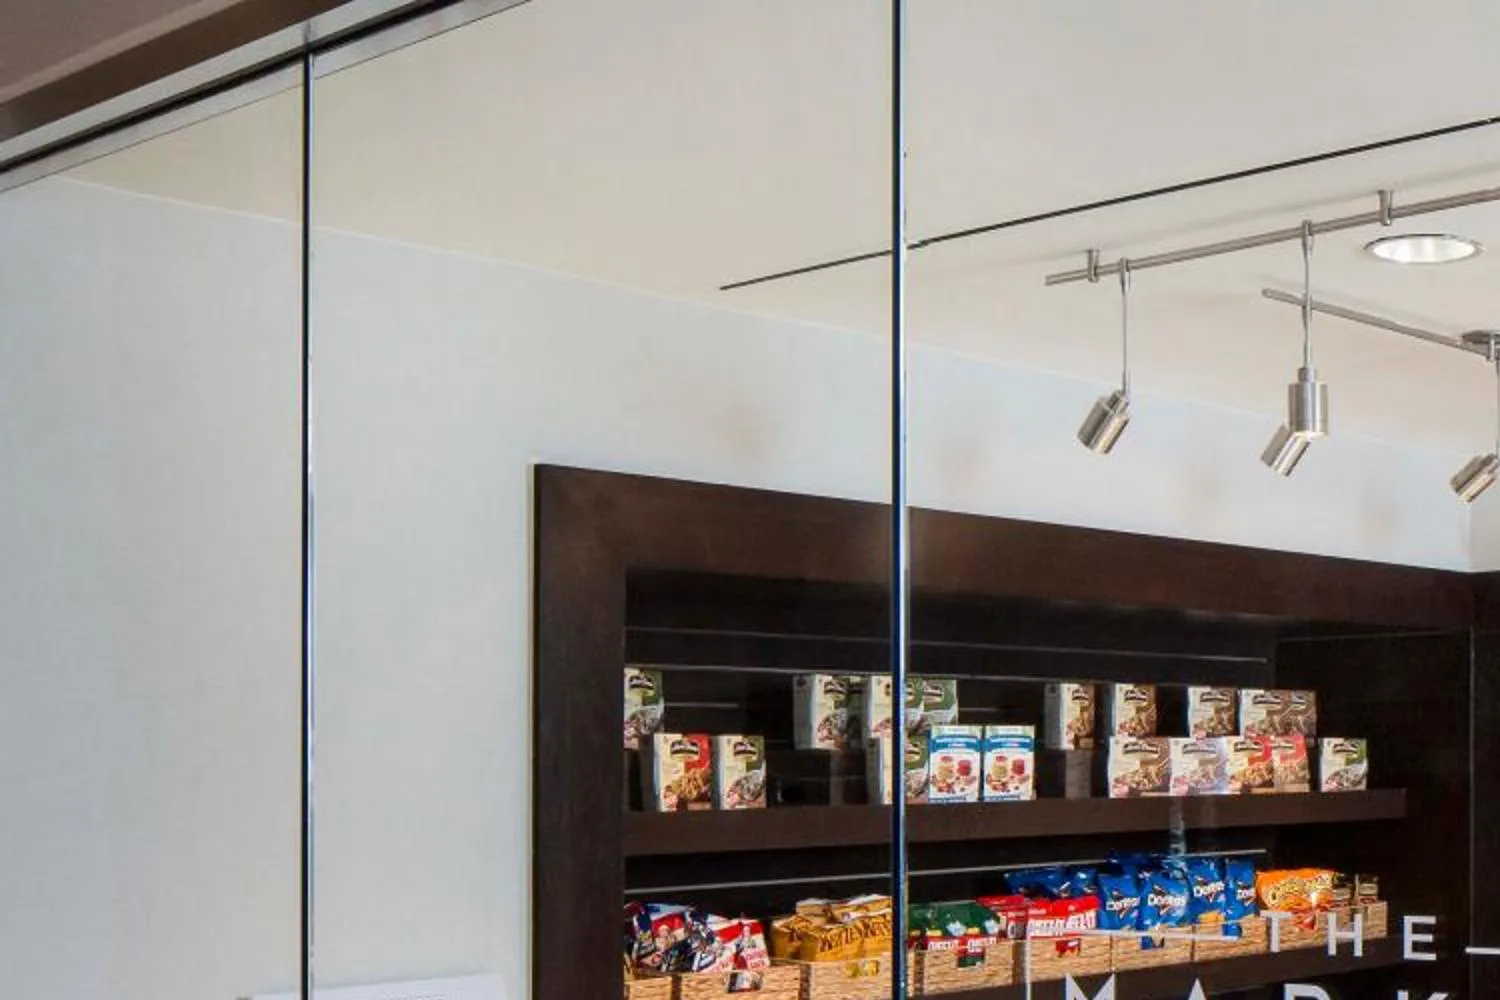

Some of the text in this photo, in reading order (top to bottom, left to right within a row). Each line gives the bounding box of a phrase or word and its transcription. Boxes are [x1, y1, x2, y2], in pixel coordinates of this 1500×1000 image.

[1105, 897, 1140, 912] Doritos
[1148, 893, 1187, 908] Doritos
[1262, 910, 1436, 961] THE
